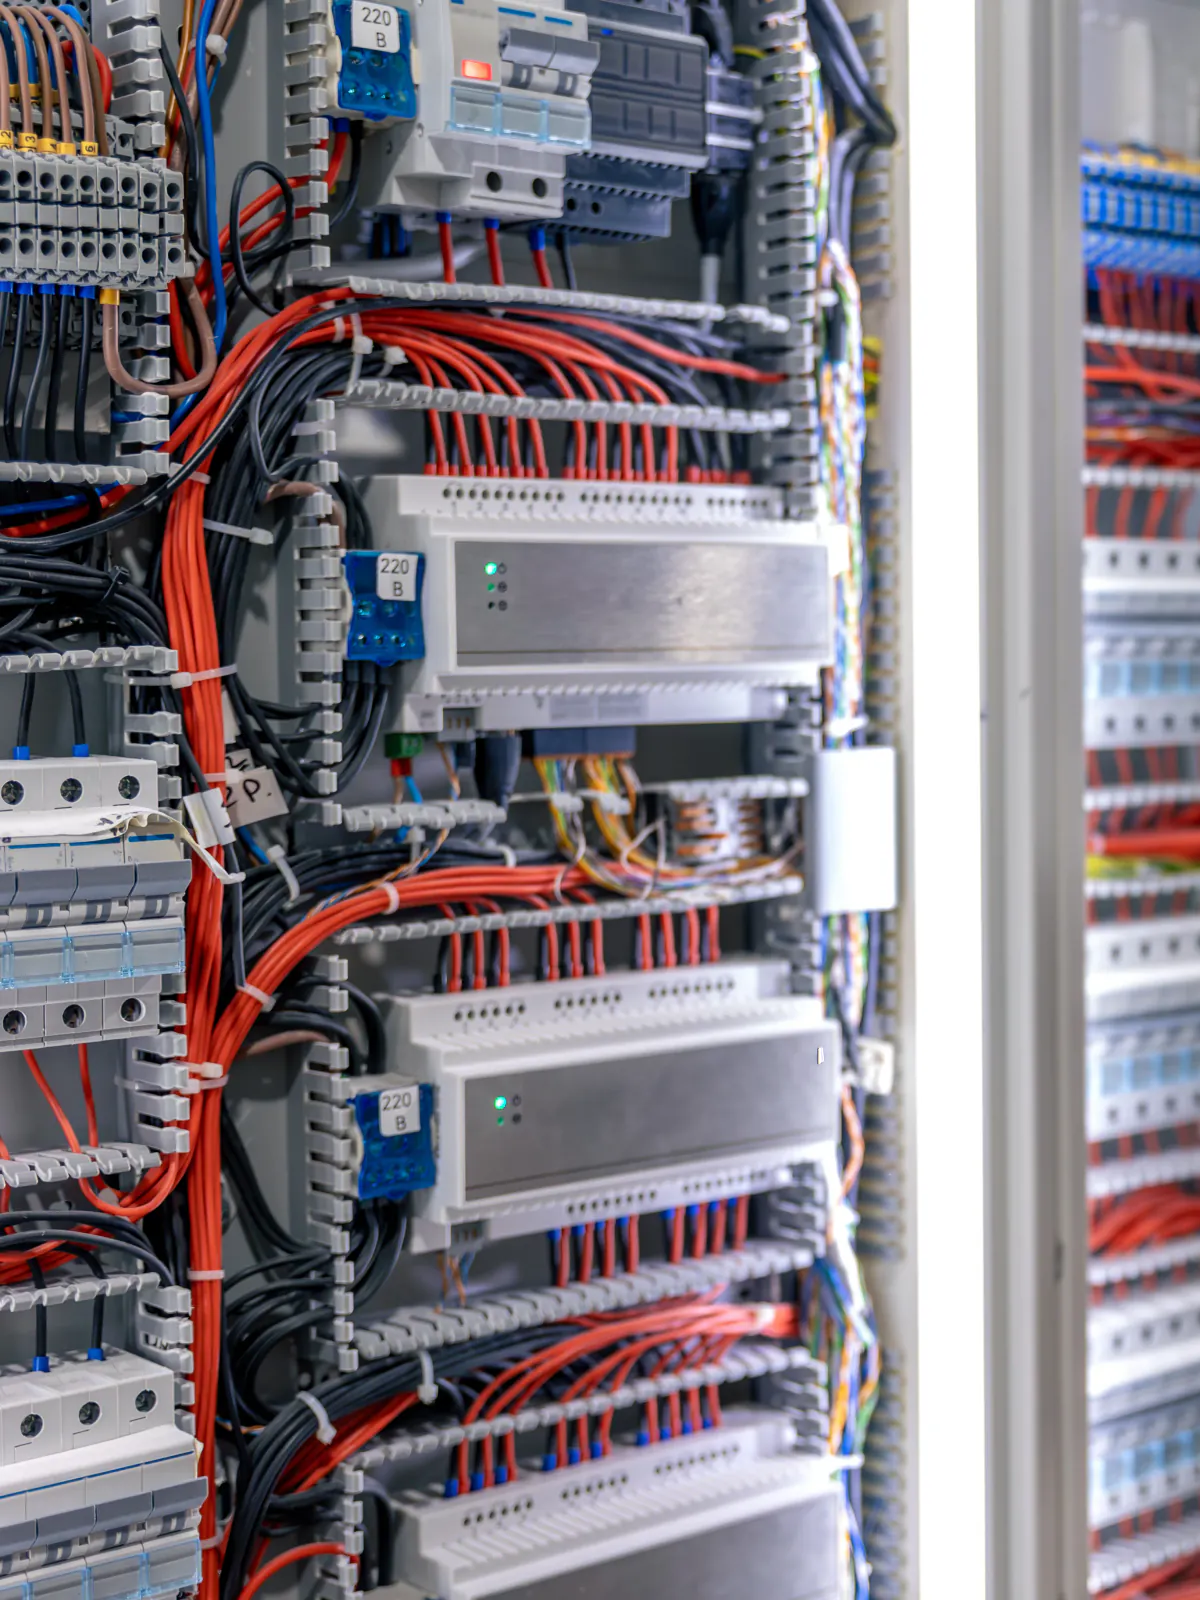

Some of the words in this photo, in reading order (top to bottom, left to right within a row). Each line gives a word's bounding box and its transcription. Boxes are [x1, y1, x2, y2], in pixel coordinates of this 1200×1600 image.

[361, 6, 391, 26] 220
[376, 32, 387, 48] B
[25, 135, 36, 143] 3
[380, 558, 410, 575] 220
[393, 581, 404, 597] B
[382, 1092, 411, 1111] 220
[395, 1115, 407, 1132] B
